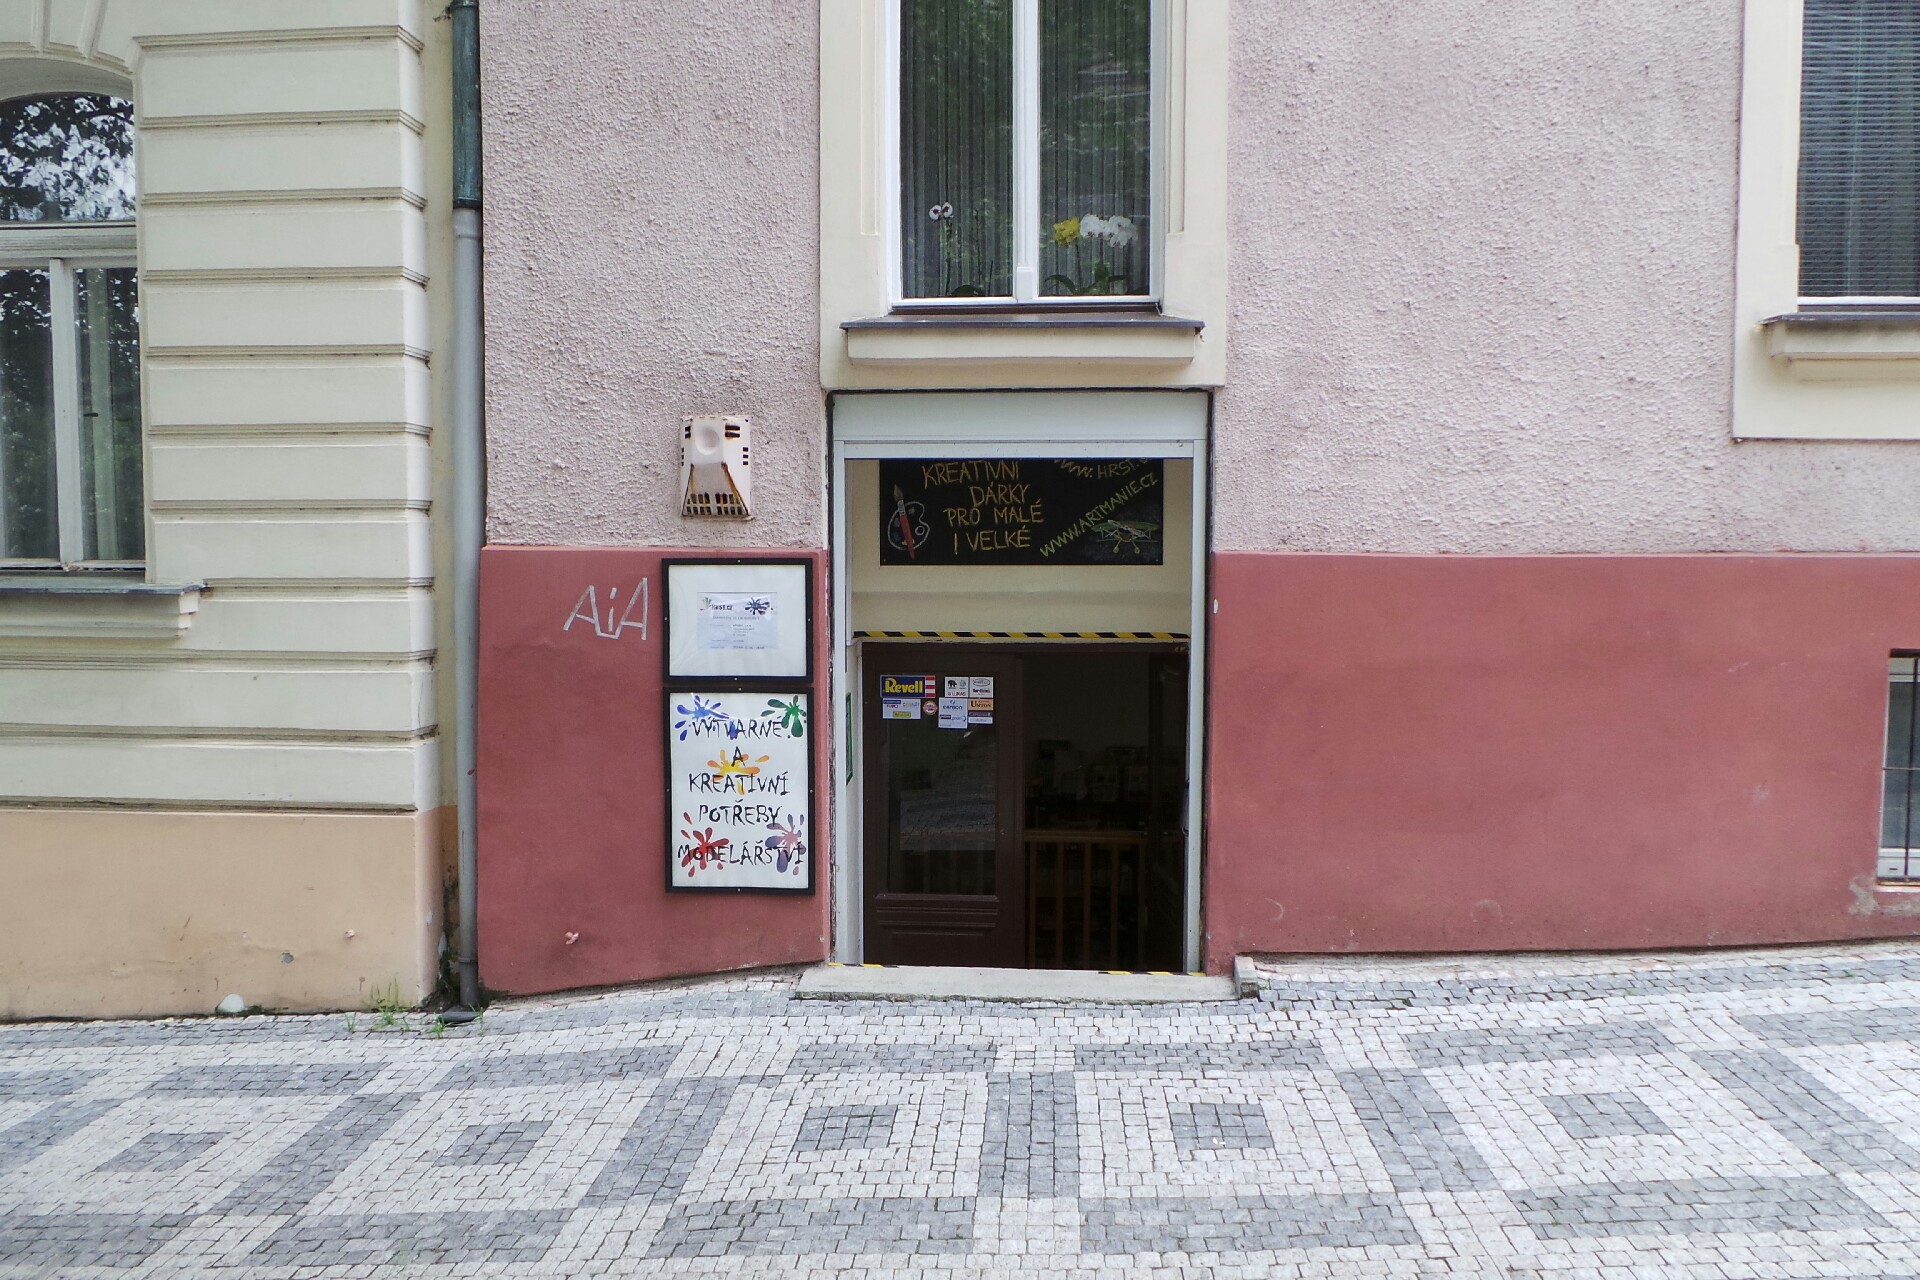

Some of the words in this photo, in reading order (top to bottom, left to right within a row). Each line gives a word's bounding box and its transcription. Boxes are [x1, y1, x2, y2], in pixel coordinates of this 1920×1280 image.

[969, 480, 1030, 507] DÁRKY
[943, 507, 981, 527] PRO
[994, 500, 1044, 525] MALÉ
[1039, 472, 1158, 558] WWW.ARTMANIE.CZ
[953, 532, 959, 555] I
[966, 525, 1031, 551] VELKÉ
[884, 677, 923, 694] Revell
[692, 715, 782, 740] VÝTVARNÉ
[731, 746, 746, 768] A
[688, 771, 790, 796] KREATIVNÍ
[699, 798, 782, 827] POTŘEBY
[677, 840, 805, 866] MODELÁŘSTVÍ
